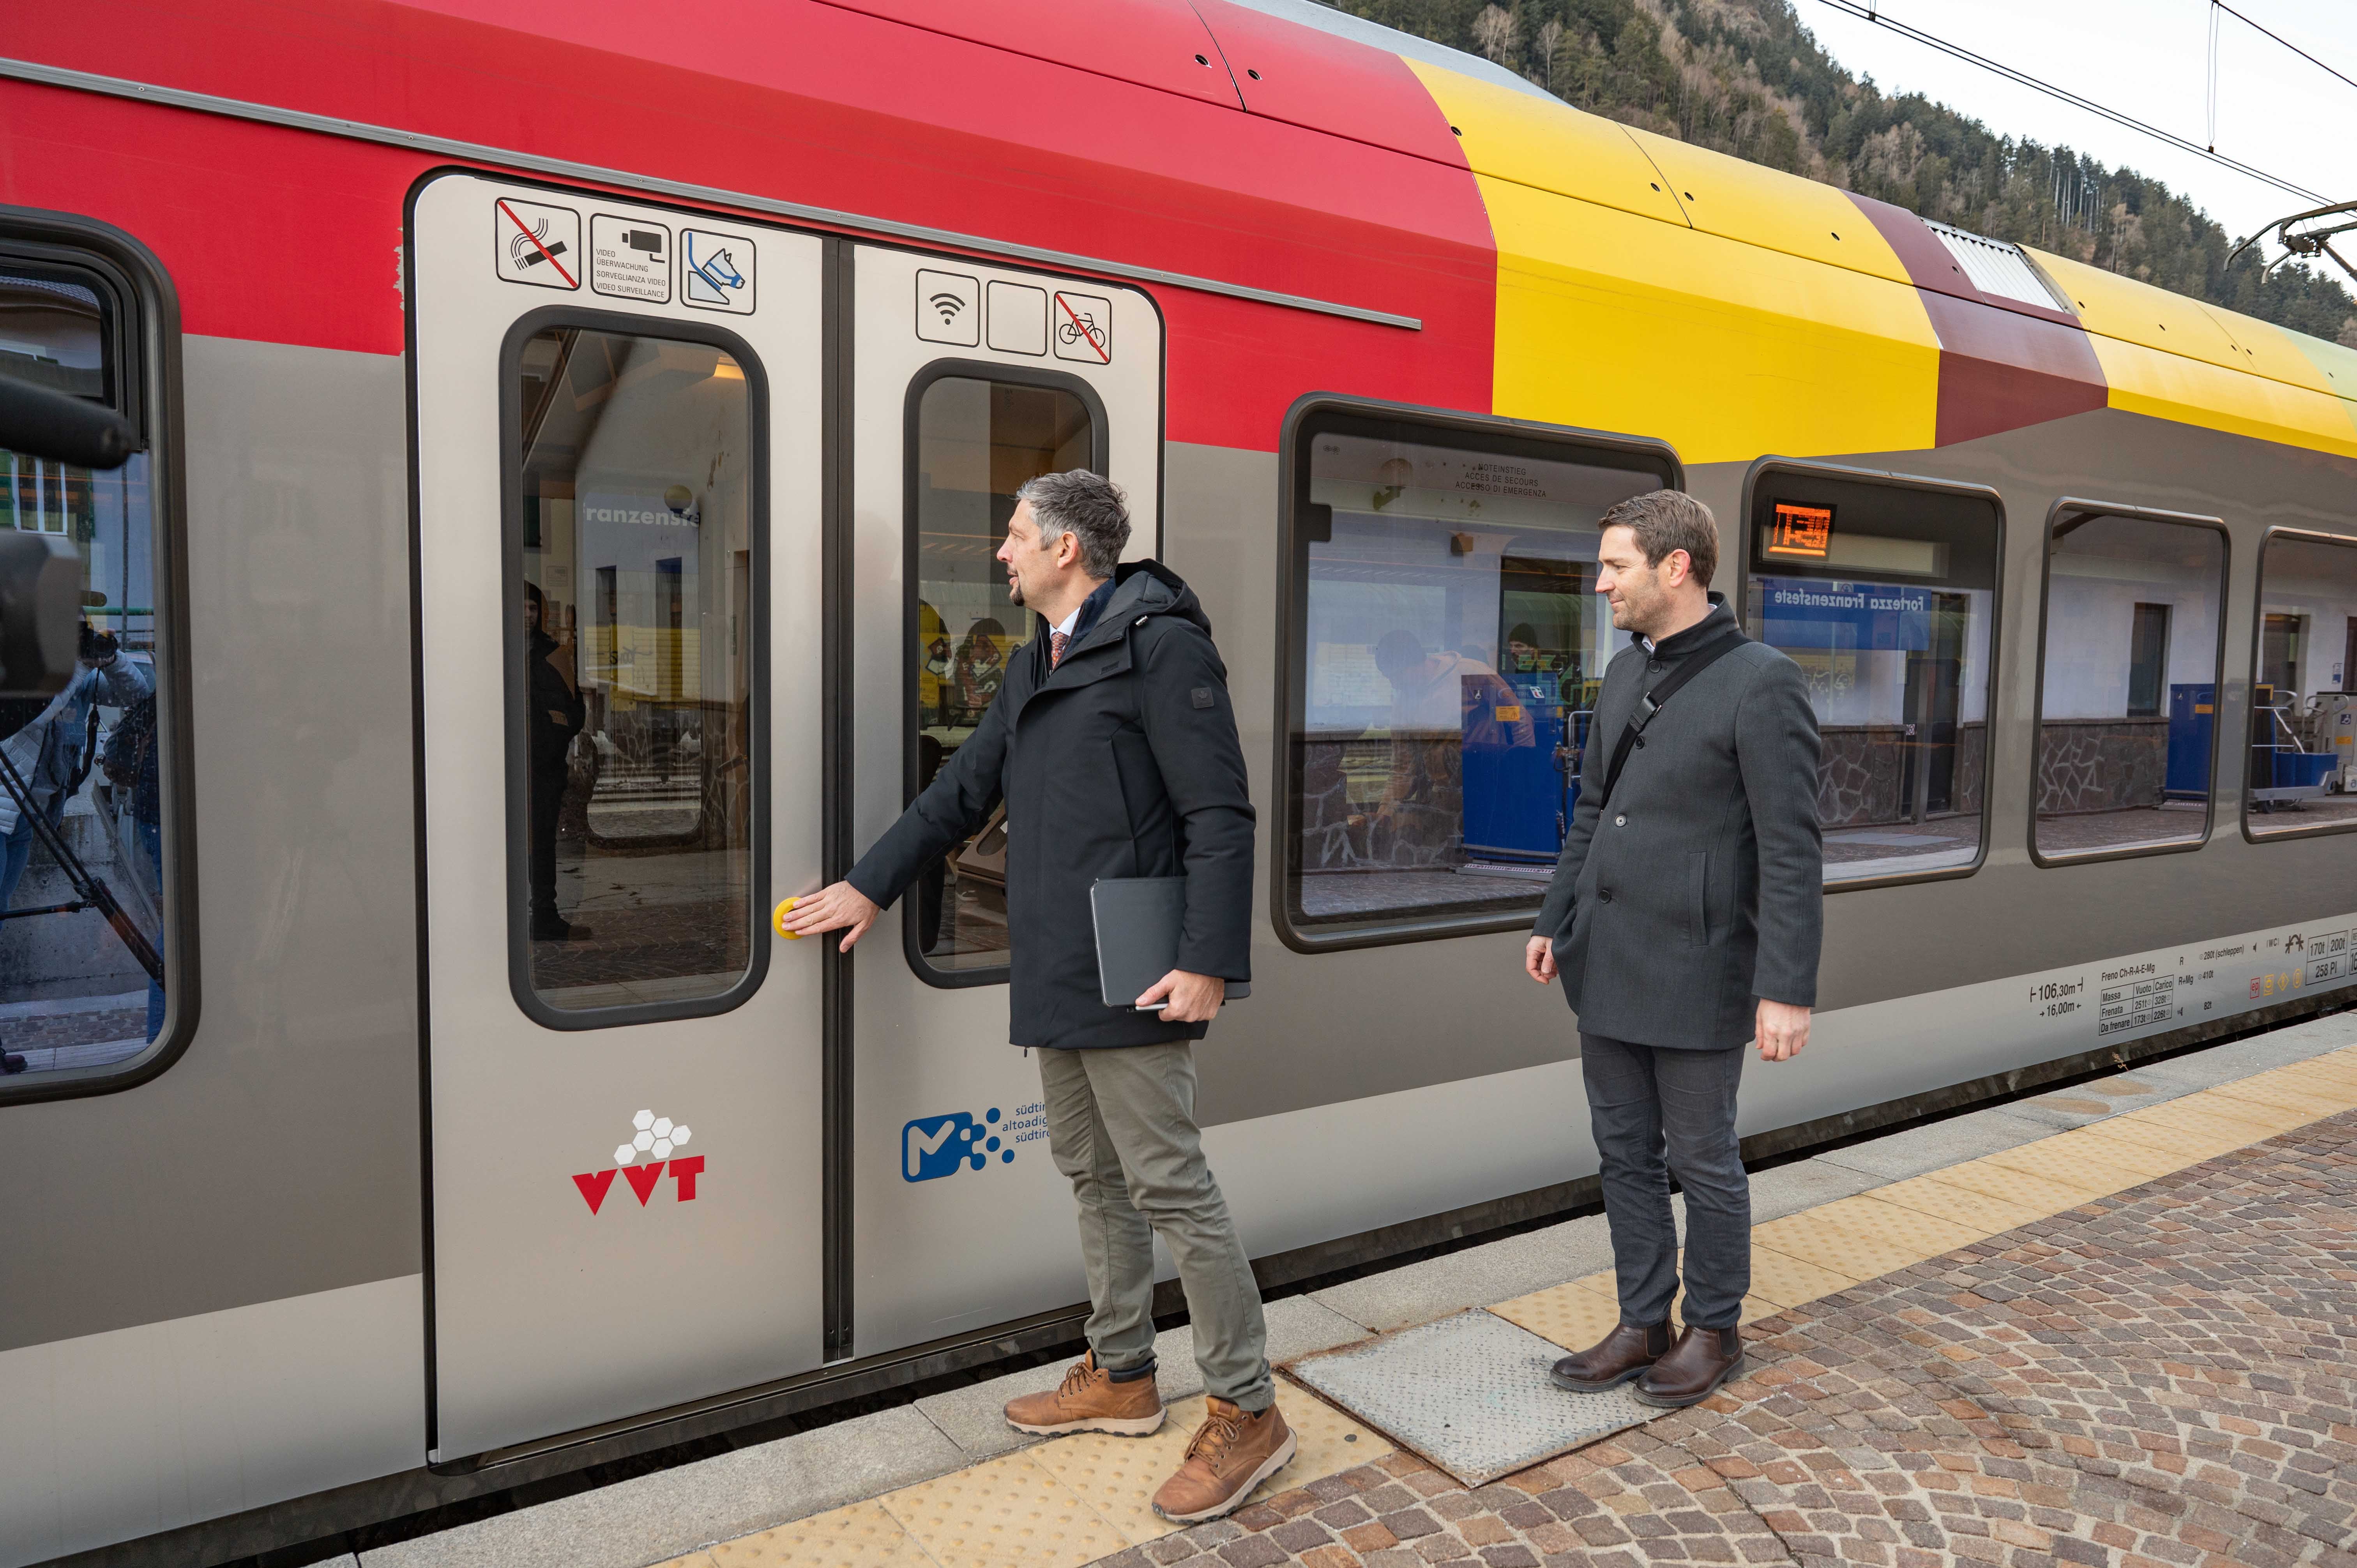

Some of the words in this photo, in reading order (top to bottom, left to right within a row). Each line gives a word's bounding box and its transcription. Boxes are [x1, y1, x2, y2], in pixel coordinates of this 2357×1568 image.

[596, 249, 615, 257] VIDEO
[597, 257, 648, 272] ÜBERWACHUNG
[596, 270, 646, 283] SORVEGLIANZA
[647, 277, 666, 286] VIDEO
[597, 282, 615, 291] VIDEO
[618, 285, 664, 298] SURVEILLANCE
[1478, 463, 1526, 475] NOTEINSTIEG
[1465, 472, 1489, 481] ACCES
[1505, 476, 1538, 487] SECOURS
[1456, 481, 1490, 491] ACCESSO
[1504, 486, 1546, 497] EMERGENZA
[2203, 950, 2215, 960] 280t
[2215, 944, 2244, 960] (schleppen)
[2310, 941, 2325, 956] 170t
[2330, 938, 2346, 952] 200t
[2179, 957, 2184, 966] R
[2101, 971, 2118, 982] Freno
[2120, 963, 2155, 978] Ch-R-A-E-Mg
[2179, 975, 2193, 985] R+Mg
[2203, 970, 2214, 980] 410t
[2315, 963, 2329, 978] 258
[2039, 983, 2075, 1001] 106,30m
[2102, 992, 2121, 1003] Massa
[2136, 985, 2152, 995] Vuoto
[2155, 980, 2172, 991] Carico
[2251, 982, 2259, 994] ep
[2047, 1001, 2074, 1017] 16,00m
[2101, 1005, 2123, 1018] Frenata
[2134, 999, 2147, 1010] 251t
[2154, 994, 2166, 1005] 328t
[2204, 1001, 2212, 1010] 82t
[2101, 1024, 2109, 1033] Da
[2110, 1019, 2130, 1031] frenare
[2134, 1014, 2146, 1024] 173t
[2154, 1010, 2166, 1020] 226t
[571, 1155, 705, 1216] VVT
